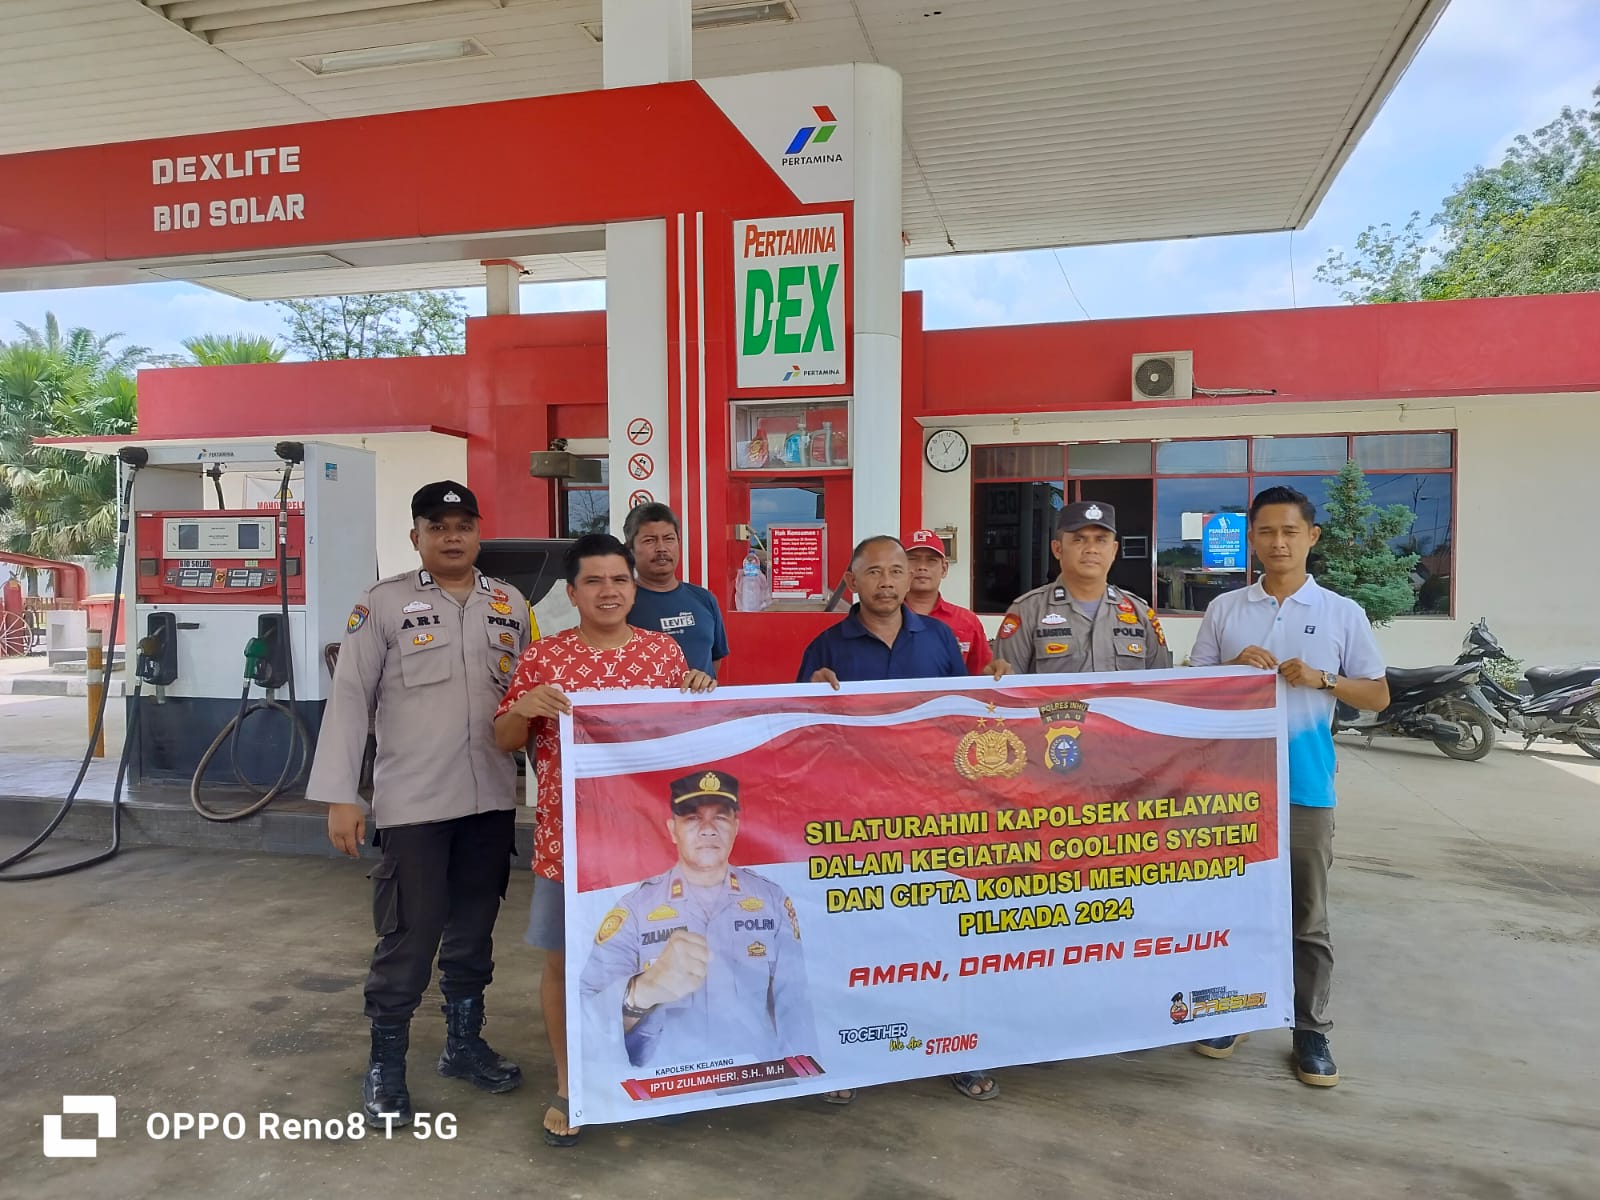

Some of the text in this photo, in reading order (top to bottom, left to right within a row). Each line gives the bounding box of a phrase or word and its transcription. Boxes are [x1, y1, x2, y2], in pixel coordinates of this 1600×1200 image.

[152, 146, 300, 185] DEXLITE
[782, 154, 843, 166] PERTAMINA
[153, 194, 305, 232] BIO SOLAR
[744, 225, 836, 258] PERTAMINA
[742, 264, 839, 356] DEX
[803, 368, 840, 377] PERTAMINA
[487, 615, 521, 631] POLRI
[1113, 627, 1145, 638] POLRI
[1040, 702, 1087, 713] POLRES INHU
[1046, 713, 1081, 722] RIAU
[805, 791, 1260, 845] SILATURAHMI KAPOLSEK KELAYANG
[809, 823, 1258, 880] DALAM KEGIATAN COOLING SYSTEM
[827, 855, 1246, 913] DAN CIPTA KONDISI MENGHADAPI
[734, 918, 775, 932] POLRI
[959, 897, 1133, 936] PILKADA 2024
[849, 929, 1230, 987] AMAN, DAMAI DAN SEJUK
[1193, 992, 1267, 1018] PRESISI
[838, 1022, 908, 1044] TOGETHER
[889, 1033, 979, 1055] We Are STRONG
[650, 1080, 675, 1093] IPTU
[766, 1064, 785, 1076] M.H
[655, 1058, 734, 1076] KAPOLSEK KELAYANG
